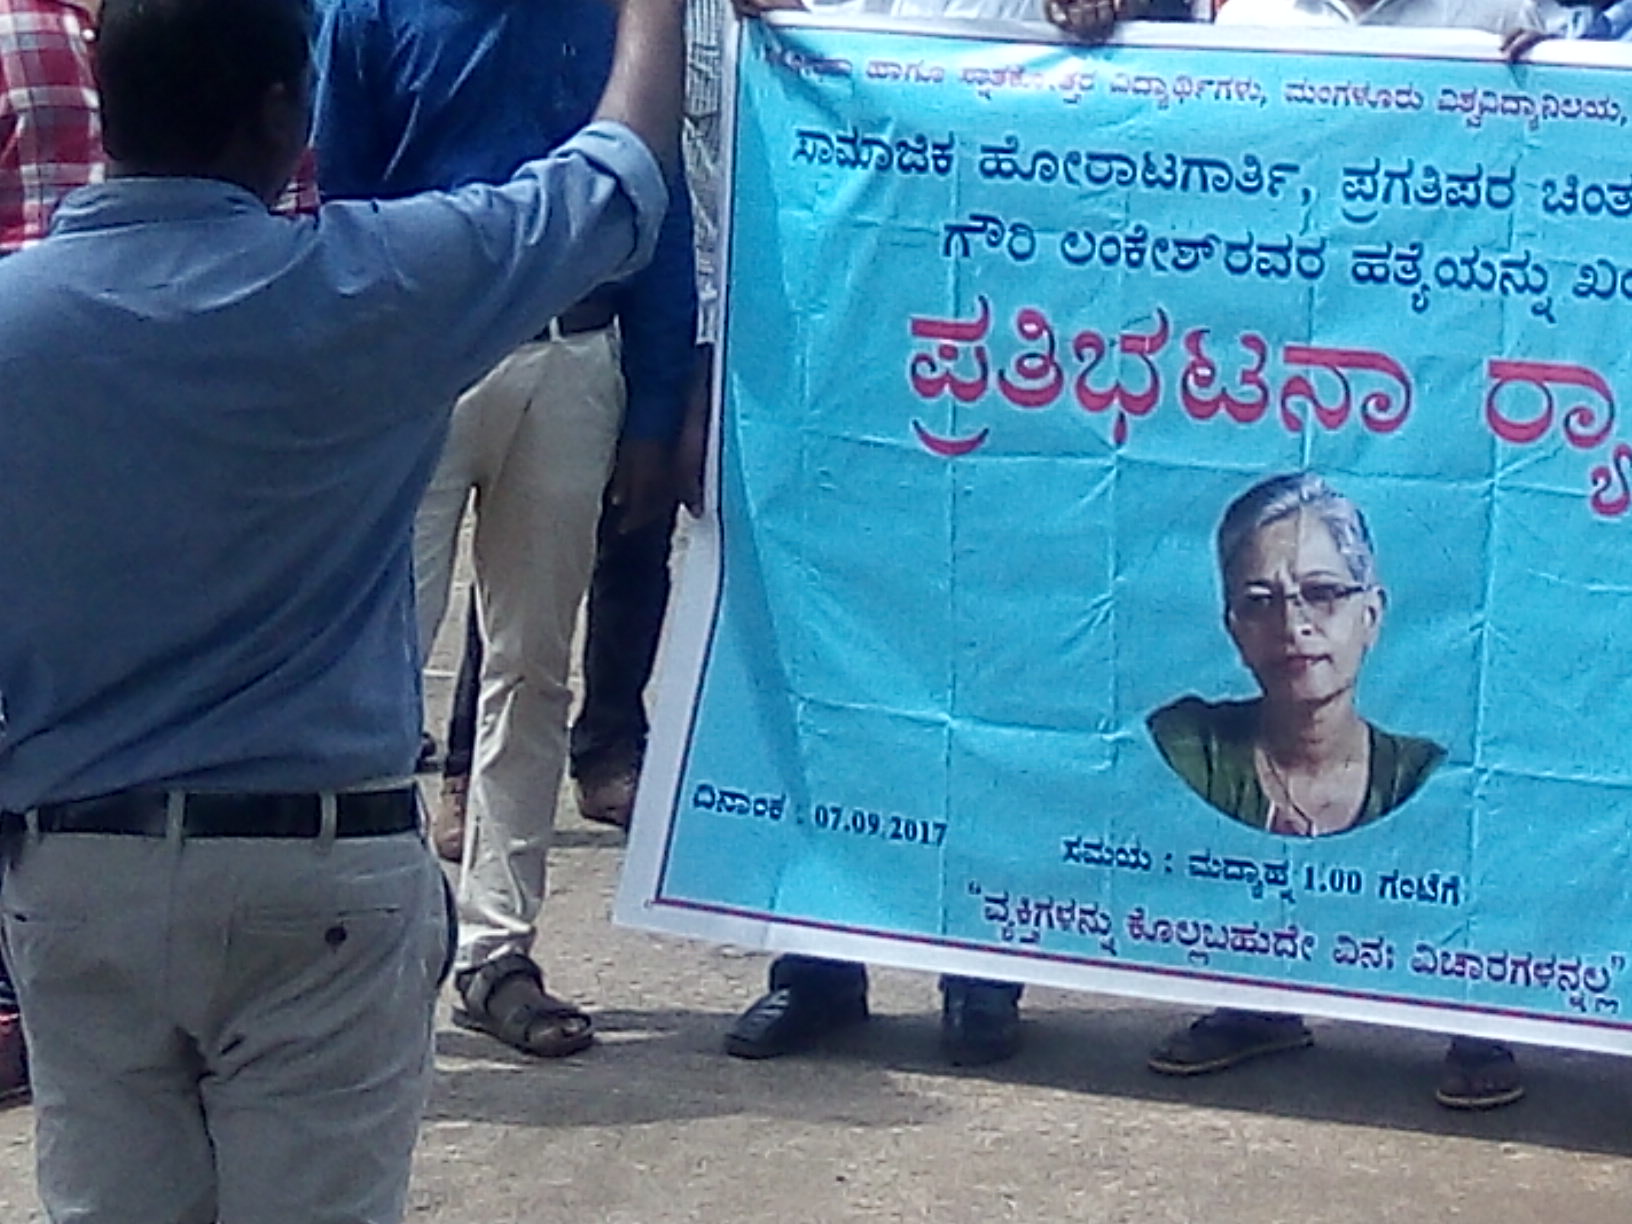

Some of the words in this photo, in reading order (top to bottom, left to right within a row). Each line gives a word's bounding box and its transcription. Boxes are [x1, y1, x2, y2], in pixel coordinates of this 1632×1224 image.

[1284, 77, 1425, 112] ಮಂಗಳೂರು
[791, 124, 957, 177] ಸಾಮಾಜಿಕ
[980, 133, 1314, 209] ಹೋರಾಟಗಾರ್ತಿ,
[1341, 156, 1518, 225] ಪ್ರಗತಿಪರ
[941, 211, 1037, 264] ಗೌರಿ
[1350, 239, 1557, 325] ಹತ್ಯೆಯನ್ನು
[907, 293, 1414, 457] ಪ್ರತಿಭಟನಾ
[1060, 833, 1152, 872] ಸಮಯ
[1302, 863, 1363, 895] 1.00
[1378, 866, 1463, 907] ಗಂಟೆಗೆ
